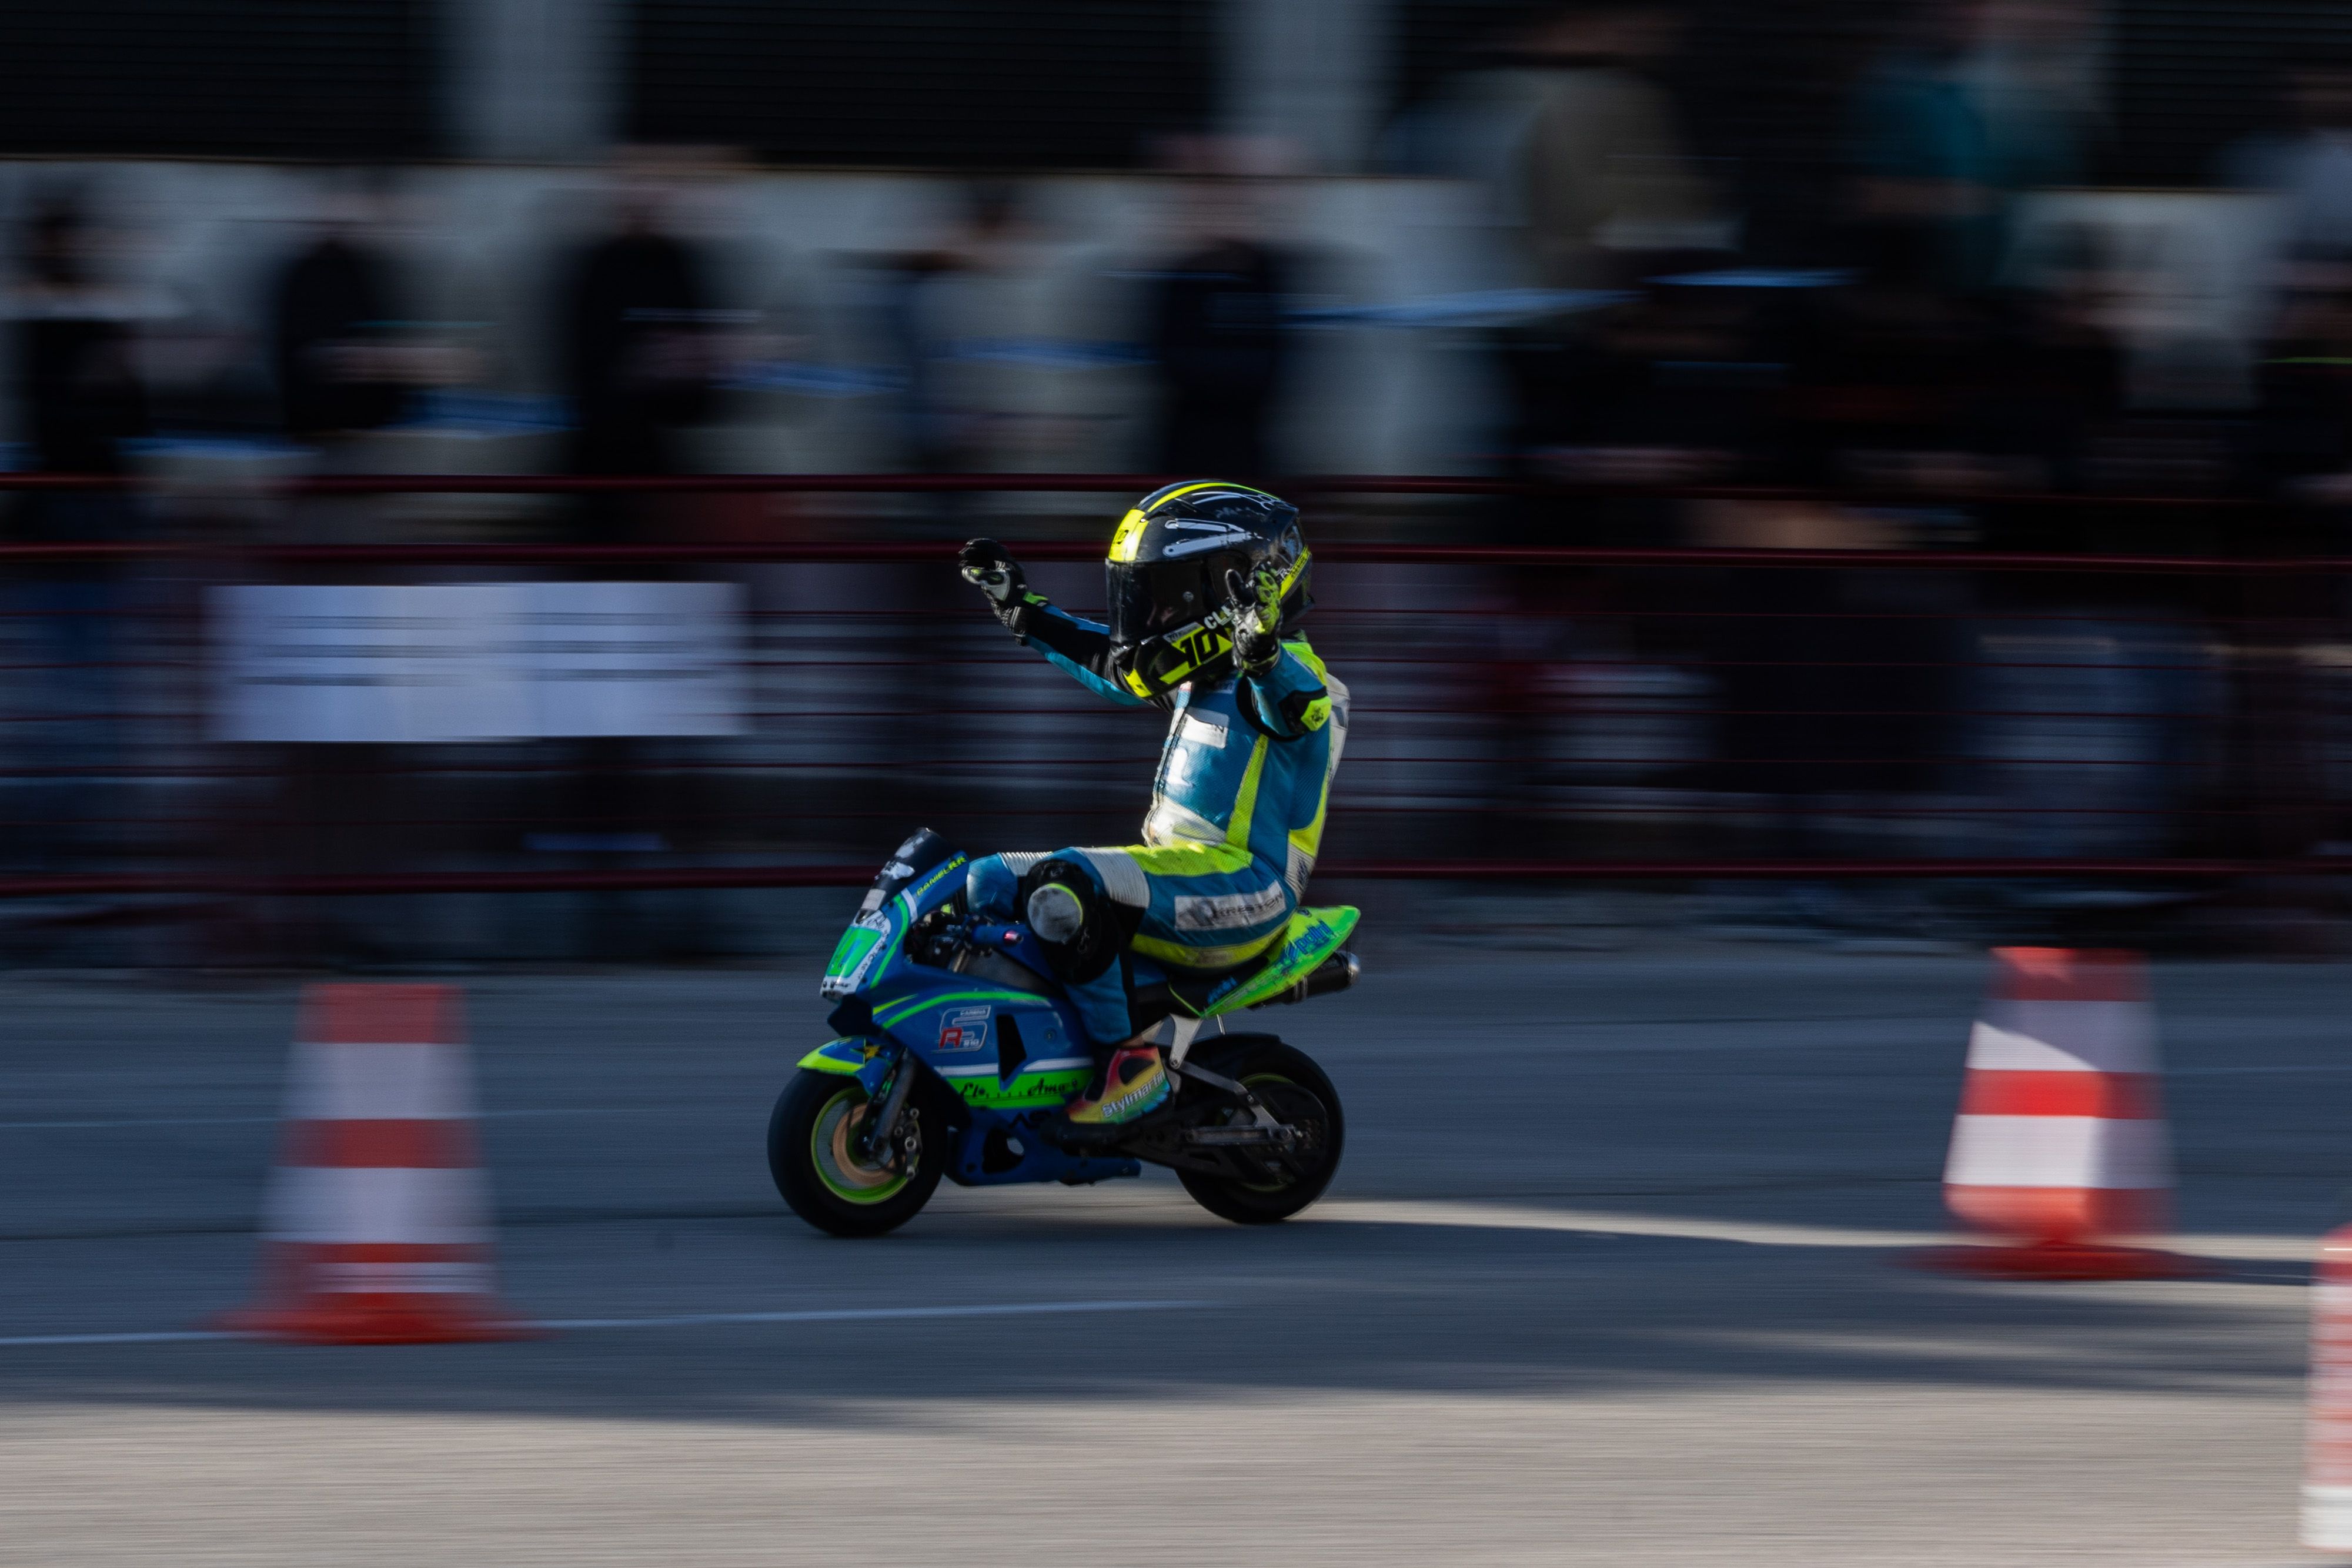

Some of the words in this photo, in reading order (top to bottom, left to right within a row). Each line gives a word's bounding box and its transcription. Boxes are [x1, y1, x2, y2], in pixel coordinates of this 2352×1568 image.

[1180, 631, 1220, 669] 10
[1295, 918, 1334, 954] polini
[1102, 1069, 1167, 1118] stylmartin
